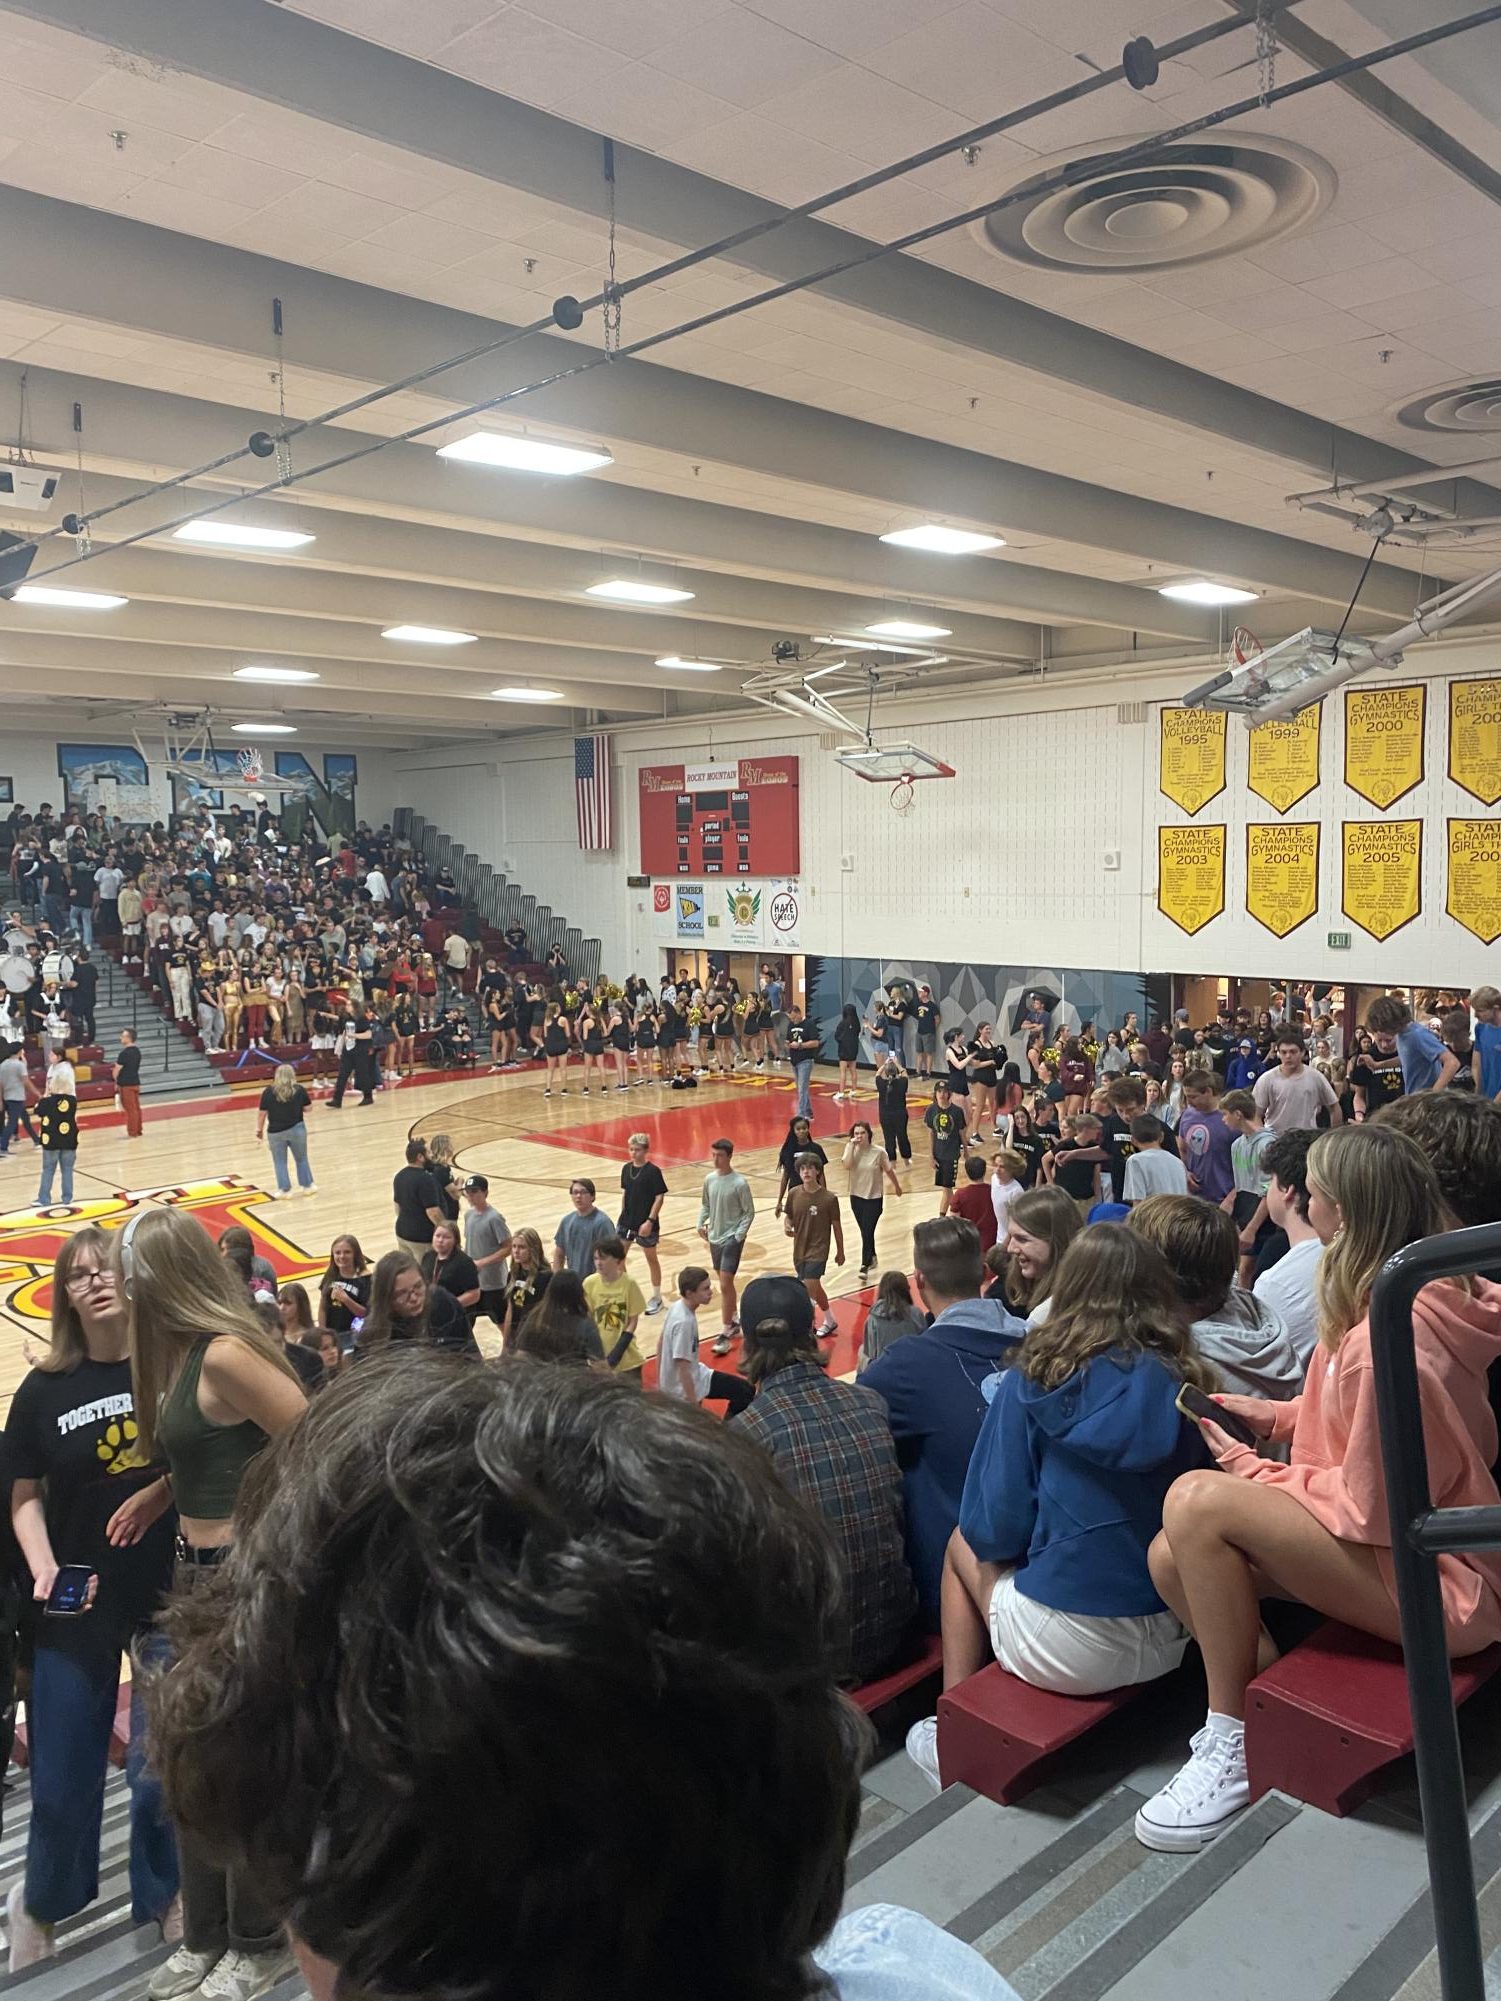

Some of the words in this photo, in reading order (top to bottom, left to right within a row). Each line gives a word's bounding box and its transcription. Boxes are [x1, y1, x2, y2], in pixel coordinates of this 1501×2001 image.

[1361, 690, 1408, 705] STATE
[1351, 699, 1419, 714] CHAMPIONS
[1455, 703, 1487, 718] GIRLS
[1166, 715, 1222, 728] CHAMPIONS
[1350, 708, 1420, 727] GYMNASTICS
[1253, 718, 1318, 733] OLLEBALL
[1366, 719, 1403, 733] 2000
[1164, 725, 1223, 739] VOLLEYBALL
[1269, 728, 1300, 740] 1999
[1179, 734, 1208, 745] 1995
[687, 773, 705, 782] ROCKY
[707, 770, 737, 780] MOUNTAIN
[1172, 829, 1211, 839] STATE
[1262, 827, 1305, 837] STATE
[1358, 824, 1405, 835] STATE
[1164, 837, 1220, 847] CHAMPIONS
[1253, 835, 1314, 844] CHAMPIONS
[1349, 832, 1415, 843] CHAMPIONS
[1163, 846, 1221, 858] GYMNASTICS
[1251, 844, 1314, 857] GYMNASTICS
[1347, 842, 1416, 856] GYMNASTICS
[1452, 841, 1485, 854] GIRLS
[1176, 855, 1207, 865] 2003
[1264, 853, 1299, 864] 2004
[1363, 852, 1400, 863] 2005
[677, 886, 703, 895] MEMBER
[774, 903, 794, 914] HATE
[678, 921, 704, 930] SCHOOL
[1331, 935, 1347, 946] EXIT
[57, 1392, 134, 1435] TOGETHER
